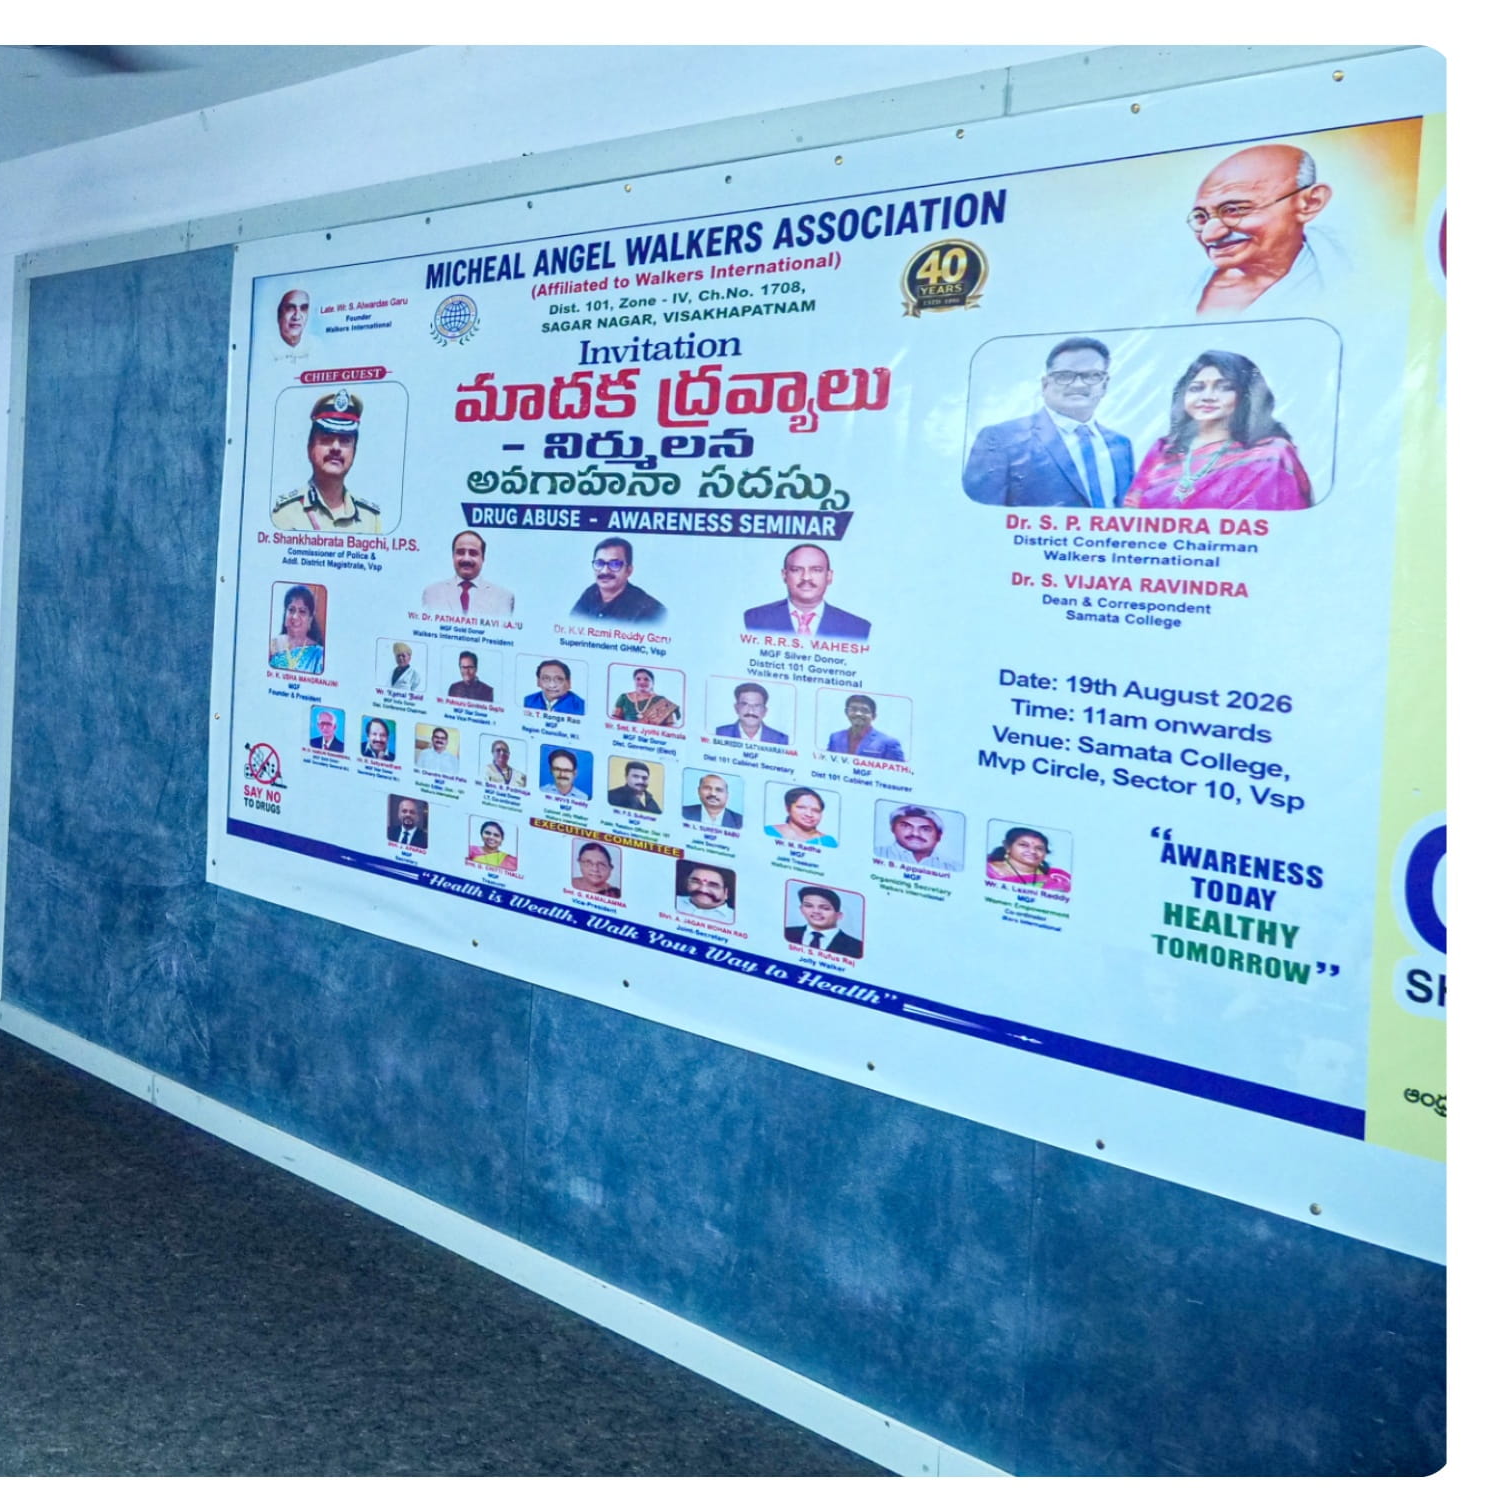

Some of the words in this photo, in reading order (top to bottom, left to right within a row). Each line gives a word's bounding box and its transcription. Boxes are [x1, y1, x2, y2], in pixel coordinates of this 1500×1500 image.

[425, 252, 526, 290] MICHEAL
[532, 240, 616, 278] ANGEL
[625, 221, 763, 266] WALKERS
[773, 188, 1007, 250] ASSOCIATION
[531, 277, 609, 300] (Affiliated
[613, 277, 630, 289] to
[636, 269, 703, 287] Walkers
[710, 251, 842, 280] International)
[916, 247, 968, 286] 40
[548, 300, 580, 316] Dist.
[586, 299, 614, 313] 101,
[618, 296, 657, 310] Zone
[672, 291, 692, 305] IV,
[699, 286, 754, 301] Ch.No.
[760, 281, 806, 296] 1708,
[920, 283, 963, 296] YEARS
[346, 313, 371, 322] Founder
[541, 319, 592, 333] SAGAR
[597, 313, 657, 329] NAGAR,
[663, 299, 817, 324] VISAKHAPATNAM
[325, 324, 349, 334] Walkers
[351, 321, 392, 332] International
[578, 331, 743, 366] Invitation
[304, 370, 340, 383] CHIEF
[342, 367, 383, 380] GUEST
[454, 367, 641, 424] మాదక
[656, 363, 892, 434] ద్రవ్యాలు
[466, 464, 681, 498] అవగాహనా
[698, 463, 851, 512] సదస్సు
[471, 507, 518, 526] DRUG
[522, 509, 581, 528] ABUSE
[608, 511, 733, 534] AWARENESS
[738, 514, 837, 537] SEMINAR
[1005, 514, 1032, 530] Dr.
[1039, 514, 1058, 531] S.
[1066, 515, 1082, 531] P.
[1089, 515, 1211, 535] RAVINDRA
[1218, 518, 1269, 536] DAS
[257, 531, 271, 544] Dr.
[273, 532, 344, 548] Shankhabrata
[346, 536, 389, 553] Bagchi,
[392, 538, 420, 552] I.P.S.
[1013, 535, 1068, 548] District
[1072, 536, 1167, 551] Conference
[1172, 539, 1259, 554] Chairman
[288, 547, 336, 559] Commissioner
[338, 550, 345, 559] of
[347, 551, 369, 561] Police
[1043, 550, 1107, 564] Walkers
[1111, 552, 1220, 568] International
[301, 558, 325, 568] District
[368, 562, 383, 572] Vsp
[1011, 572, 1035, 587] Dr.
[1041, 573, 1058, 588] S.
[1064, 574, 1132, 592] VIJAYA
[1140, 578, 1249, 598] RAVINDRA
[1042, 594, 1078, 608] Dean
[1082, 596, 1092, 608] &
[1097, 597, 1212, 615] Correspondent
[422, 613, 433, 622] Dr.
[1066, 610, 1120, 624] Samata
[1124, 613, 1182, 630] College
[413, 630, 438, 639] Walkers
[439, 632, 480, 644] International
[482, 637, 514, 647] President
[614, 630, 645, 643] Reddy
[764, 636, 804, 649] R.R.S.
[560, 638, 618, 652] Superintendent
[650, 646, 667, 657] Vsp
[760, 649, 781, 660] MGF
[784, 651, 812, 662] Silver
[747, 668, 789, 680] Walkers
[793, 673, 862, 688] International
[749, 659, 785, 670] District
[788, 663, 804, 671] 101
[808, 664, 857, 677] Governor
[999, 669, 1057, 691] Date:
[1066, 674, 1118, 697] 19th
[1122, 680, 1220, 707] August
[1226, 689, 1293, 714] 2026
[1010, 698, 1075, 722] Time:
[1082, 706, 1147, 731] 11am
[1155, 718, 1273, 744] onwards
[992, 724, 1071, 752] Venue:
[1077, 736, 1173, 764] Samata
[1180, 748, 1291, 783] College,
[761, 761, 794, 776] Secretary
[853, 767, 872, 777] MGF
[876, 780, 912, 793] Treasurer
[978, 749, 1026, 776] Mvp
[1032, 757, 1106, 787] Circle,
[1112, 768, 1196, 797] Sector
[1204, 780, 1242, 806] 10,
[1250, 784, 1305, 815] Vsp
[244, 785, 263, 799] SAY
[266, 789, 281, 803] NO
[244, 797, 254, 808] TO
[255, 800, 281, 815] DRUGS
[533, 818, 600, 841] EXECUTIVE
[603, 833, 681, 858] COMMITTEE
[1041, 889, 1071, 903] Reddy
[1190, 876, 1277, 912] TODAY
[488, 888, 503, 903] is
[586, 914, 640, 940] Walk
[648, 929, 698, 955] Your
[705, 946, 758, 972] Way
[765, 963, 789, 980] to
[1163, 902, 1300, 950] HEALTHY
